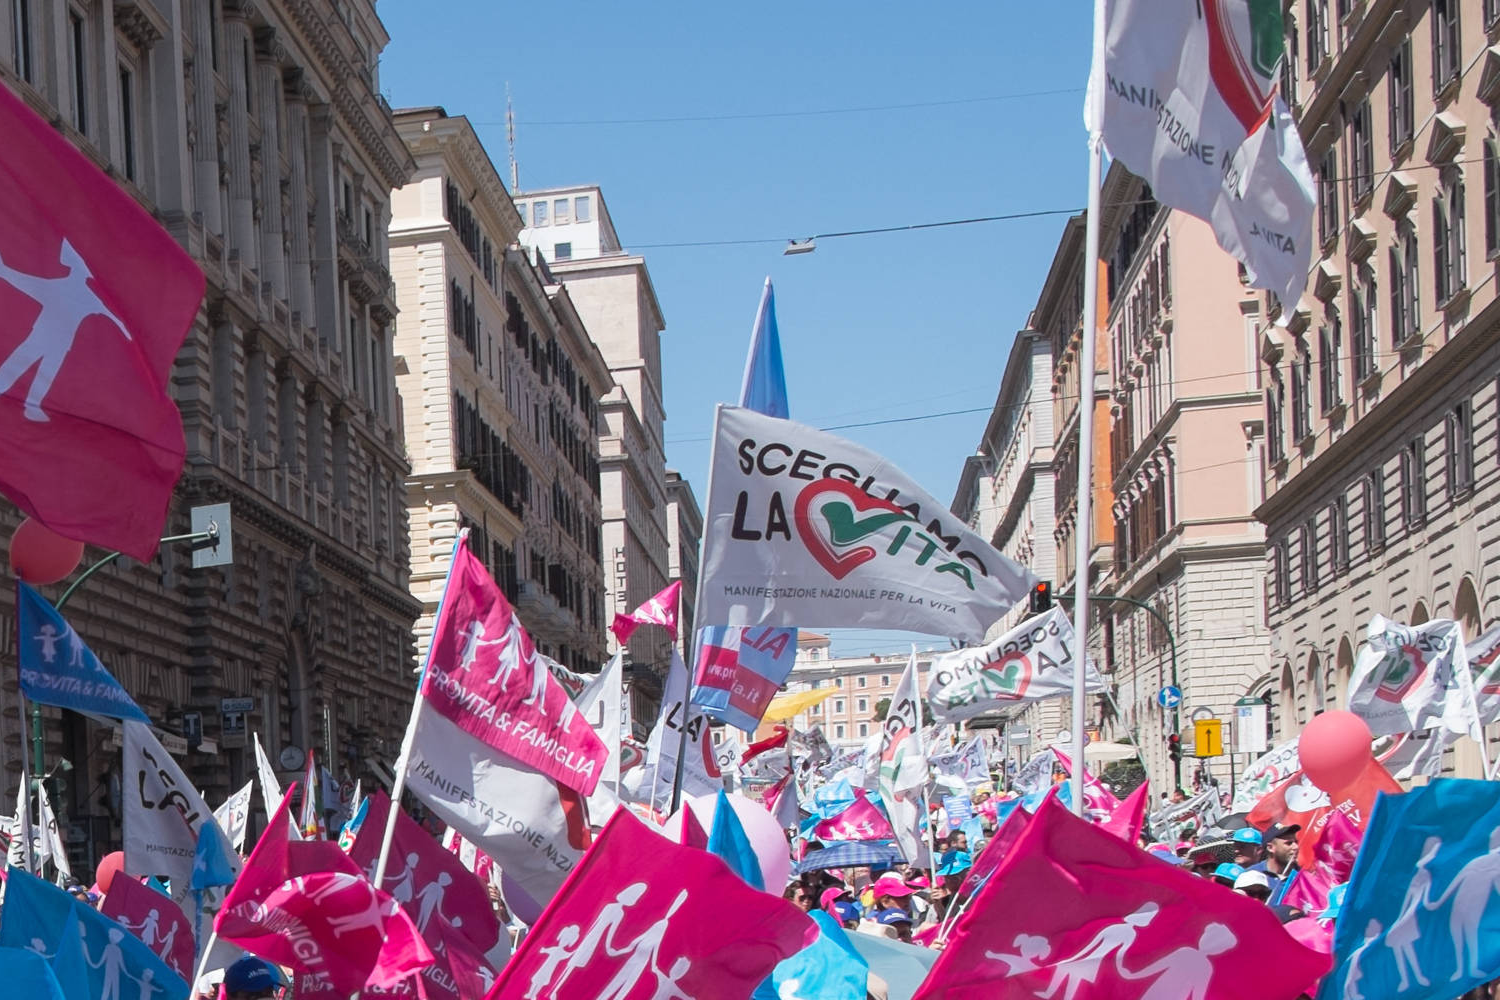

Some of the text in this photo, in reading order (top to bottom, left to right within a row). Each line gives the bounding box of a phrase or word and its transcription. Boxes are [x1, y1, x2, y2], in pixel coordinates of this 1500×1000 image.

[731, 490, 792, 541] LA
[615, 547, 626, 602] HOTE
[724, 585, 957, 614] MANIFESTAZIONE NAZIONALE PER LA VITA
[21, 667, 81, 692] PROVITA
[427, 665, 596, 778] PROVITA & FAMIGLIA
[415, 760, 544, 848] MANIFESTAZIONE
